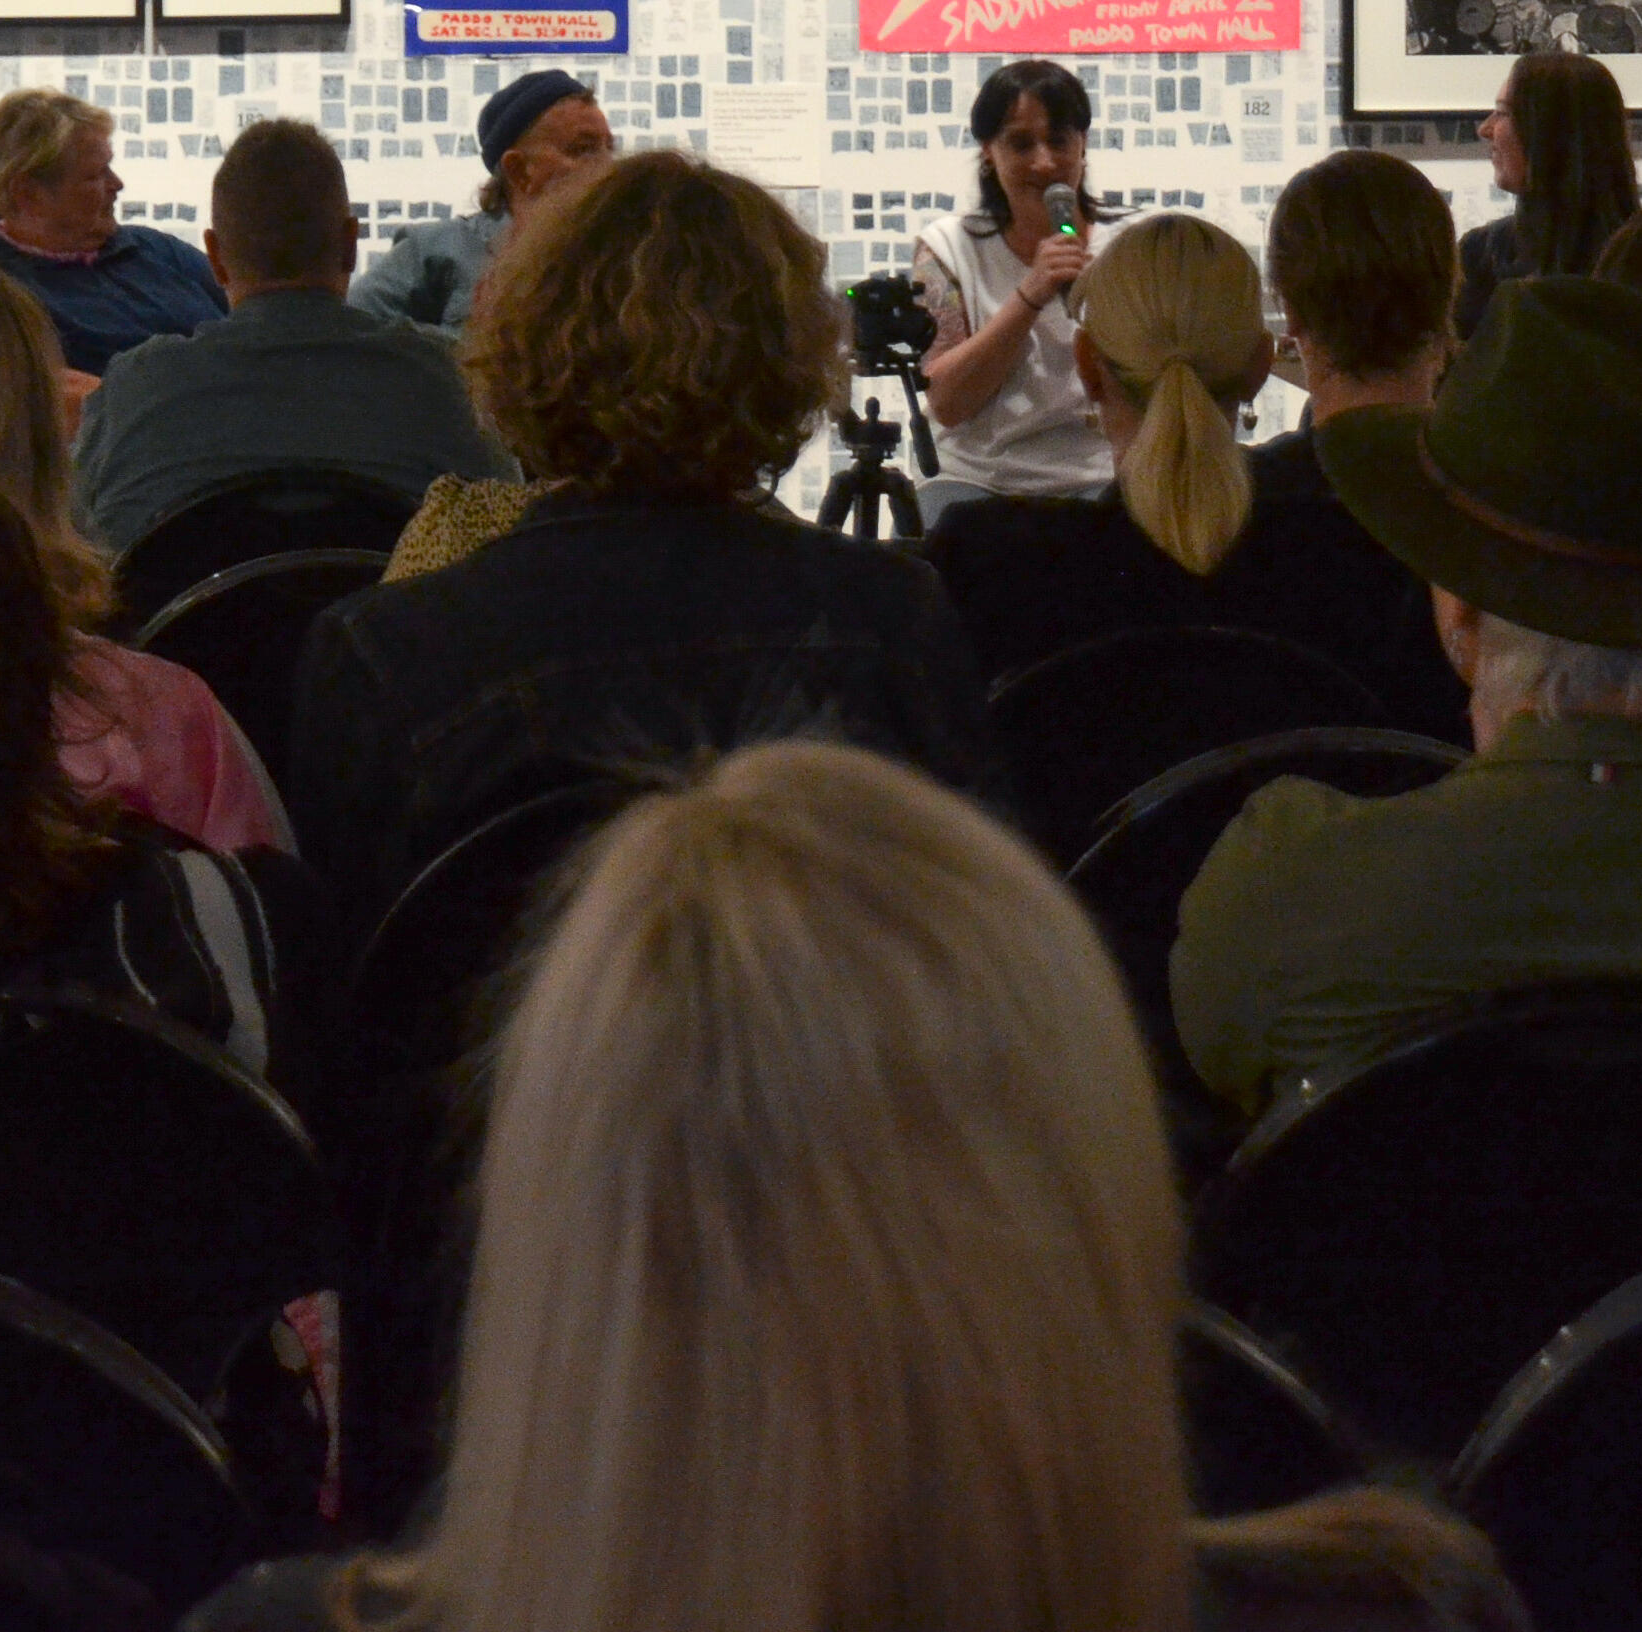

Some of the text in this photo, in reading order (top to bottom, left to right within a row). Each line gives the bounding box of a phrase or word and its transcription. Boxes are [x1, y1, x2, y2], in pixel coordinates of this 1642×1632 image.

[1095, 0, 1159, 20] FRIDAY
[502, 14, 552, 25] TOWN
[557, 14, 598, 27] HALL
[1068, 17, 1276, 48] PADDO TOWN HALL
[1243, 101, 1271, 117] 182
